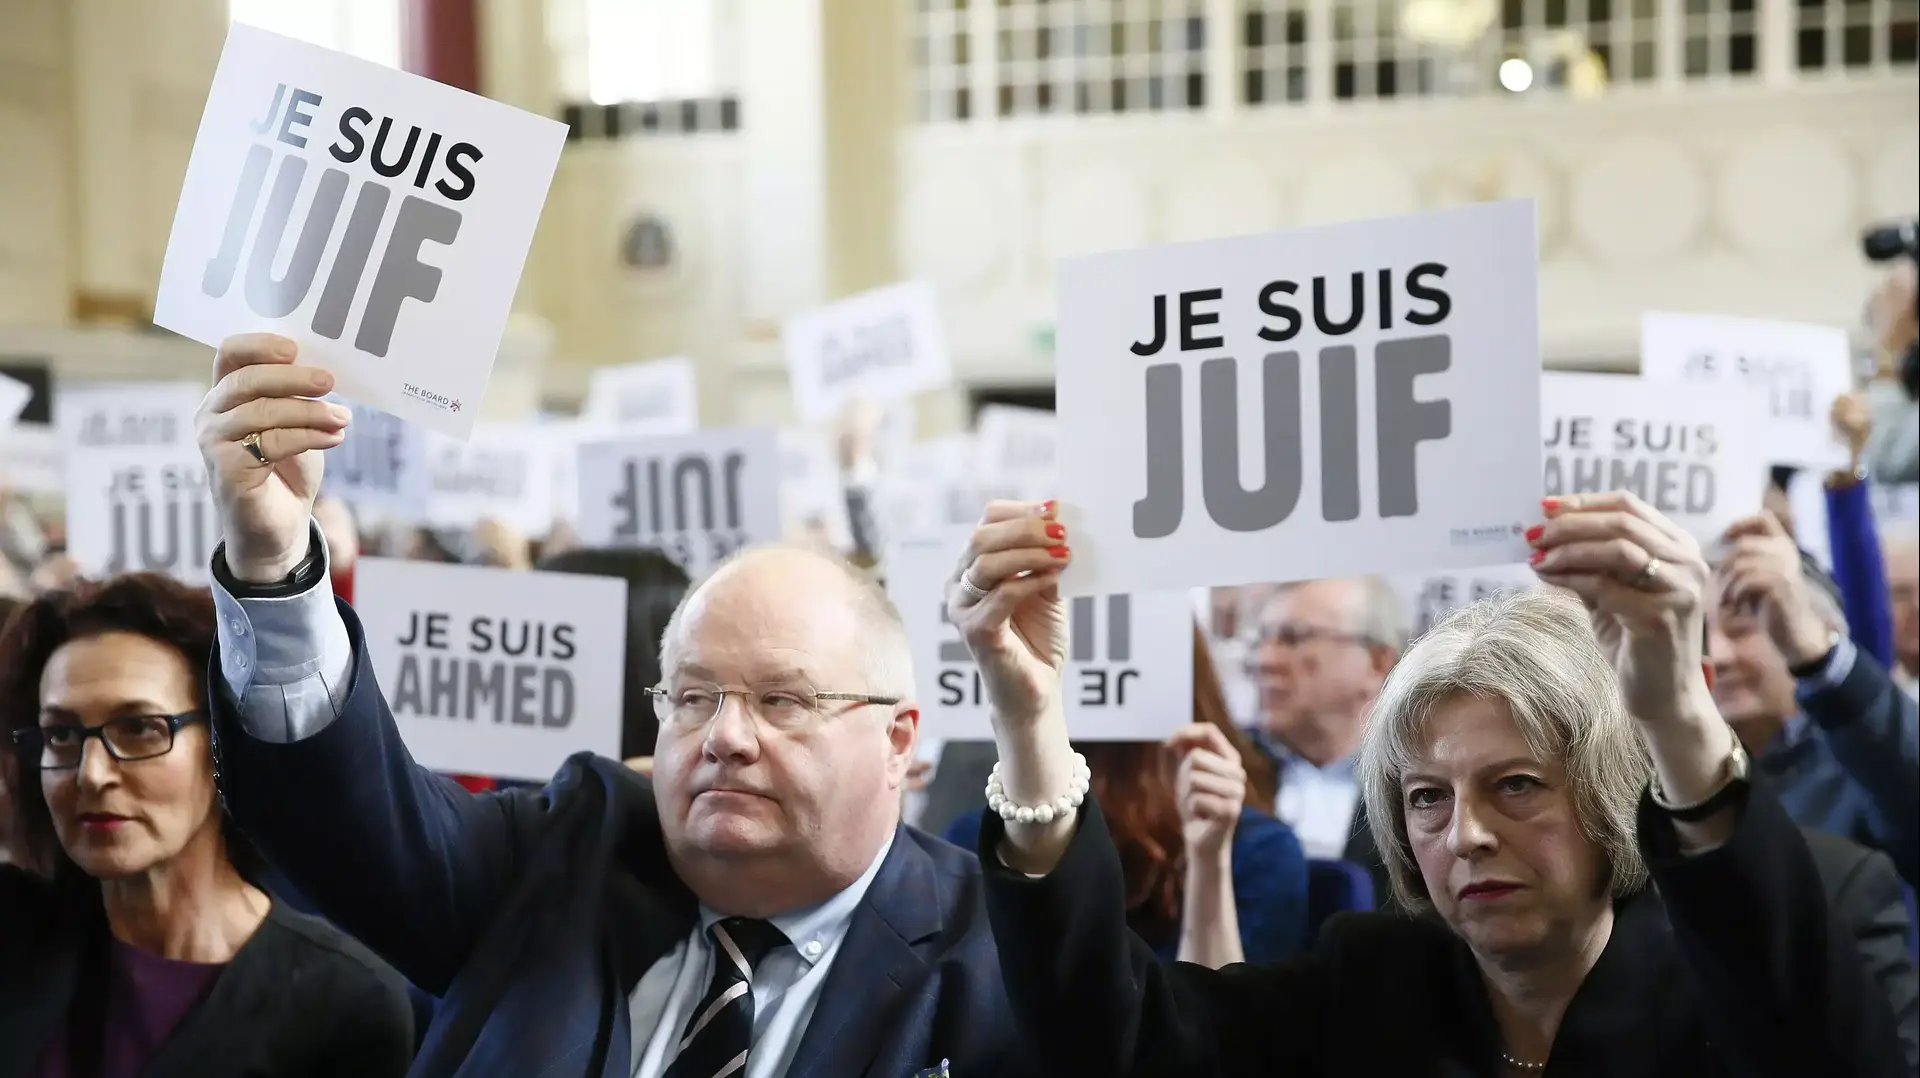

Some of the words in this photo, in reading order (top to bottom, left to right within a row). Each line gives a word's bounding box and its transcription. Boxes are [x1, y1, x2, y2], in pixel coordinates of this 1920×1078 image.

[250, 82, 323, 149] JE
[328, 106, 484, 202] SUIS
[201, 142, 463, 358] JUIF
[1129, 287, 1224, 357] JE
[1257, 262, 1452, 342] SUIS
[403, 383, 419, 395] THE
[421, 389, 449, 406] BOARD
[1132, 333, 1452, 539] JUIF
[1544, 416, 1594, 449] JE
[1613, 418, 1718, 455] SUIS
[609, 452, 746, 537] JUIF
[1544, 455, 1718, 515] AHMED
[104, 500, 206, 574] JUI
[397, 611, 450, 650] JE
[468, 616, 577, 661] SUIS
[393, 654, 576, 729] AHMED
[1080, 669, 1140, 707] JE
